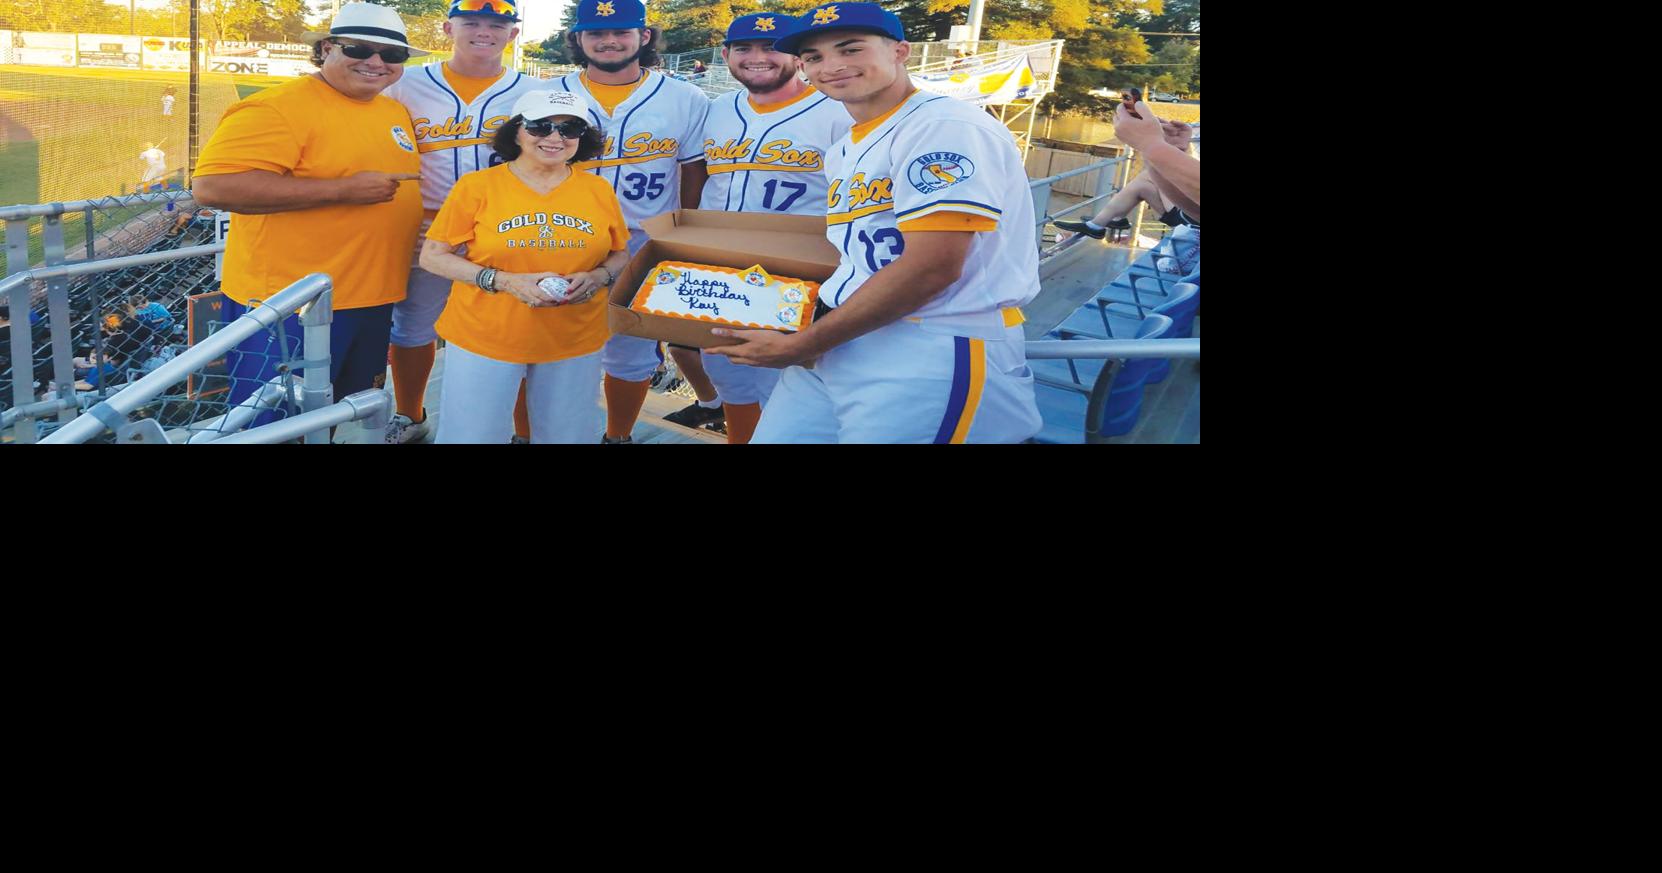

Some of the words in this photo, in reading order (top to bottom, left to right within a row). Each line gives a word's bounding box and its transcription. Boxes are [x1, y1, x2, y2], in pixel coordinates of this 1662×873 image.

[210, 61, 268, 74] ZONE
[413, 115, 473, 140] Gold
[622, 131, 679, 157] Sox
[755, 138, 820, 167] Sox
[917, 152, 942, 166] GOLD
[943, 152, 964, 164] SOX
[622, 172, 666, 201] 35
[762, 178, 807, 212] 17
[497, 212, 547, 233] GOLD
[552, 212, 595, 236] SOX
[506, 239, 587, 249] BASEBALL
[857, 227, 905, 273] 13
[680, 271, 730, 293] Happy
[675, 283, 750, 307] Birthday
[680, 297, 719, 316] Kay
